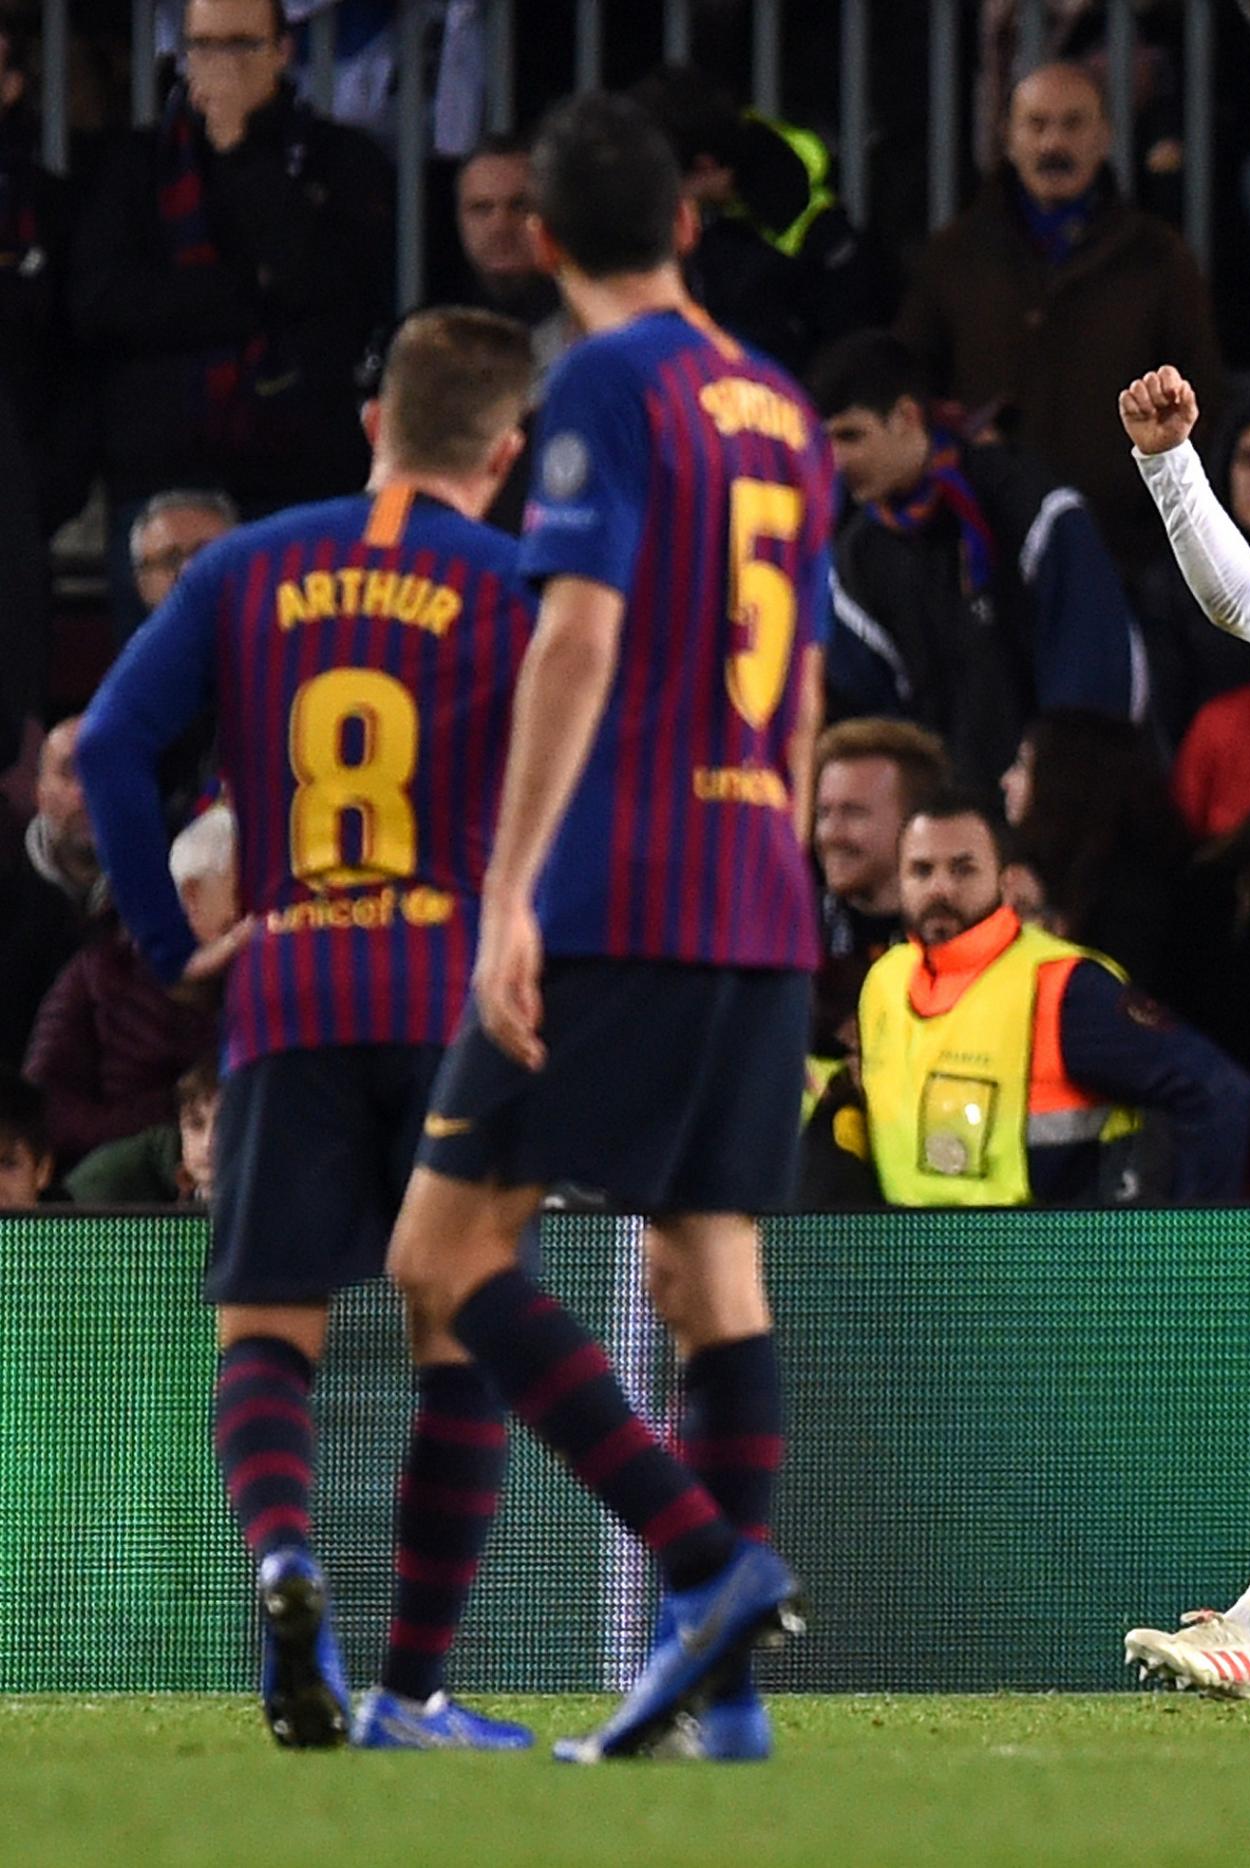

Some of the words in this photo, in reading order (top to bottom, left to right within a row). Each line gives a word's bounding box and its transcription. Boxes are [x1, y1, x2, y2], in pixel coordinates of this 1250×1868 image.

[276, 567, 463, 636] ARTHUR
[727, 476, 802, 729] 5
[289, 666, 419, 890] 8
